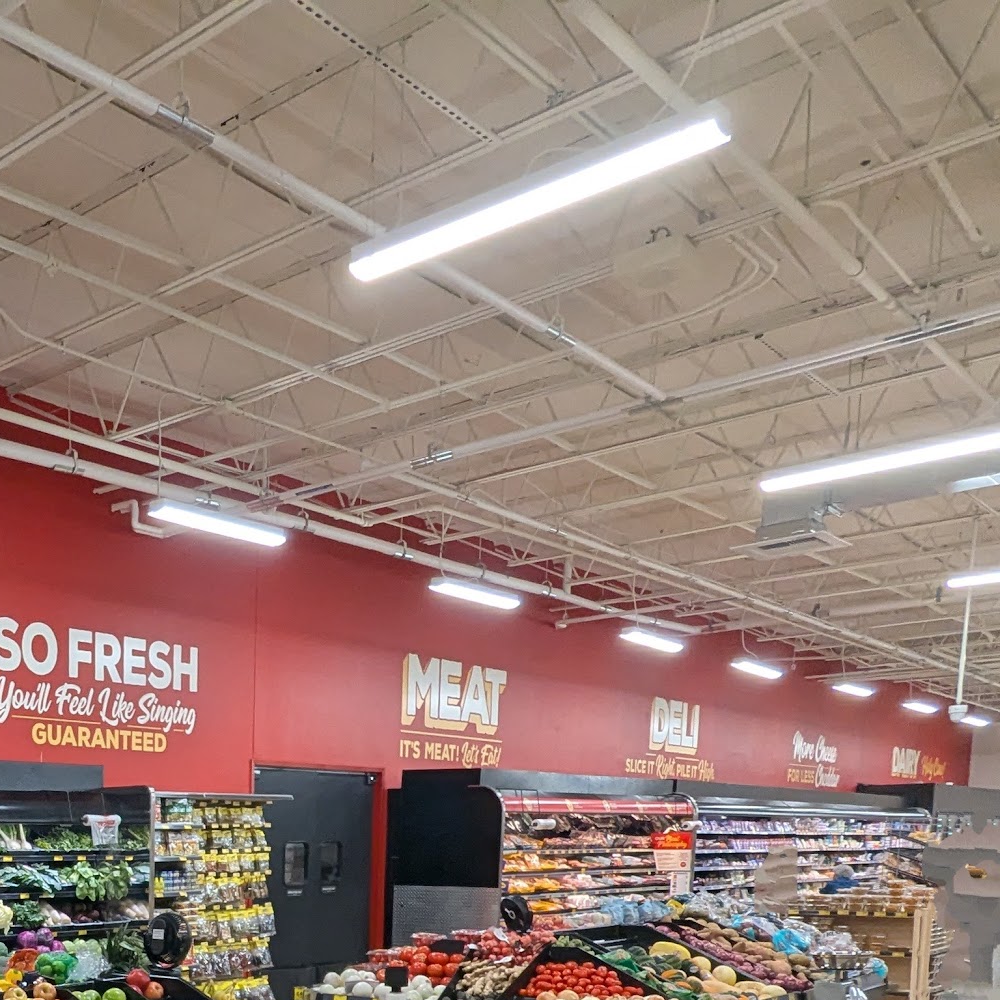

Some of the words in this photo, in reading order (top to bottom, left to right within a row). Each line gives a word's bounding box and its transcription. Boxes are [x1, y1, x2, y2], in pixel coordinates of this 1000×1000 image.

[68, 628, 199, 692] FRESH
[55, 683, 95, 716] Feel
[98, 687, 136, 727] Like
[137, 693, 197, 735] Singing
[401, 653, 507, 735] MEAT
[31, 723, 167, 752] GUARANTEED
[648, 696, 700, 755] DELI
[400, 740, 420, 759] IT'S
[424, 742, 460, 762] MEAT!
[461, 742, 479, 769] Let's
[481, 744, 502, 768] Eat!
[792, 731, 815, 762] More
[891, 746, 921, 779] DAIRY
[625, 758, 647, 774] SLICE
[647, 761, 655, 775] IT
[676, 764, 690, 778] PILE
[690, 765, 698, 779] IT
[787, 768, 800, 783] FOR
[800, 769, 815, 784] LESS
